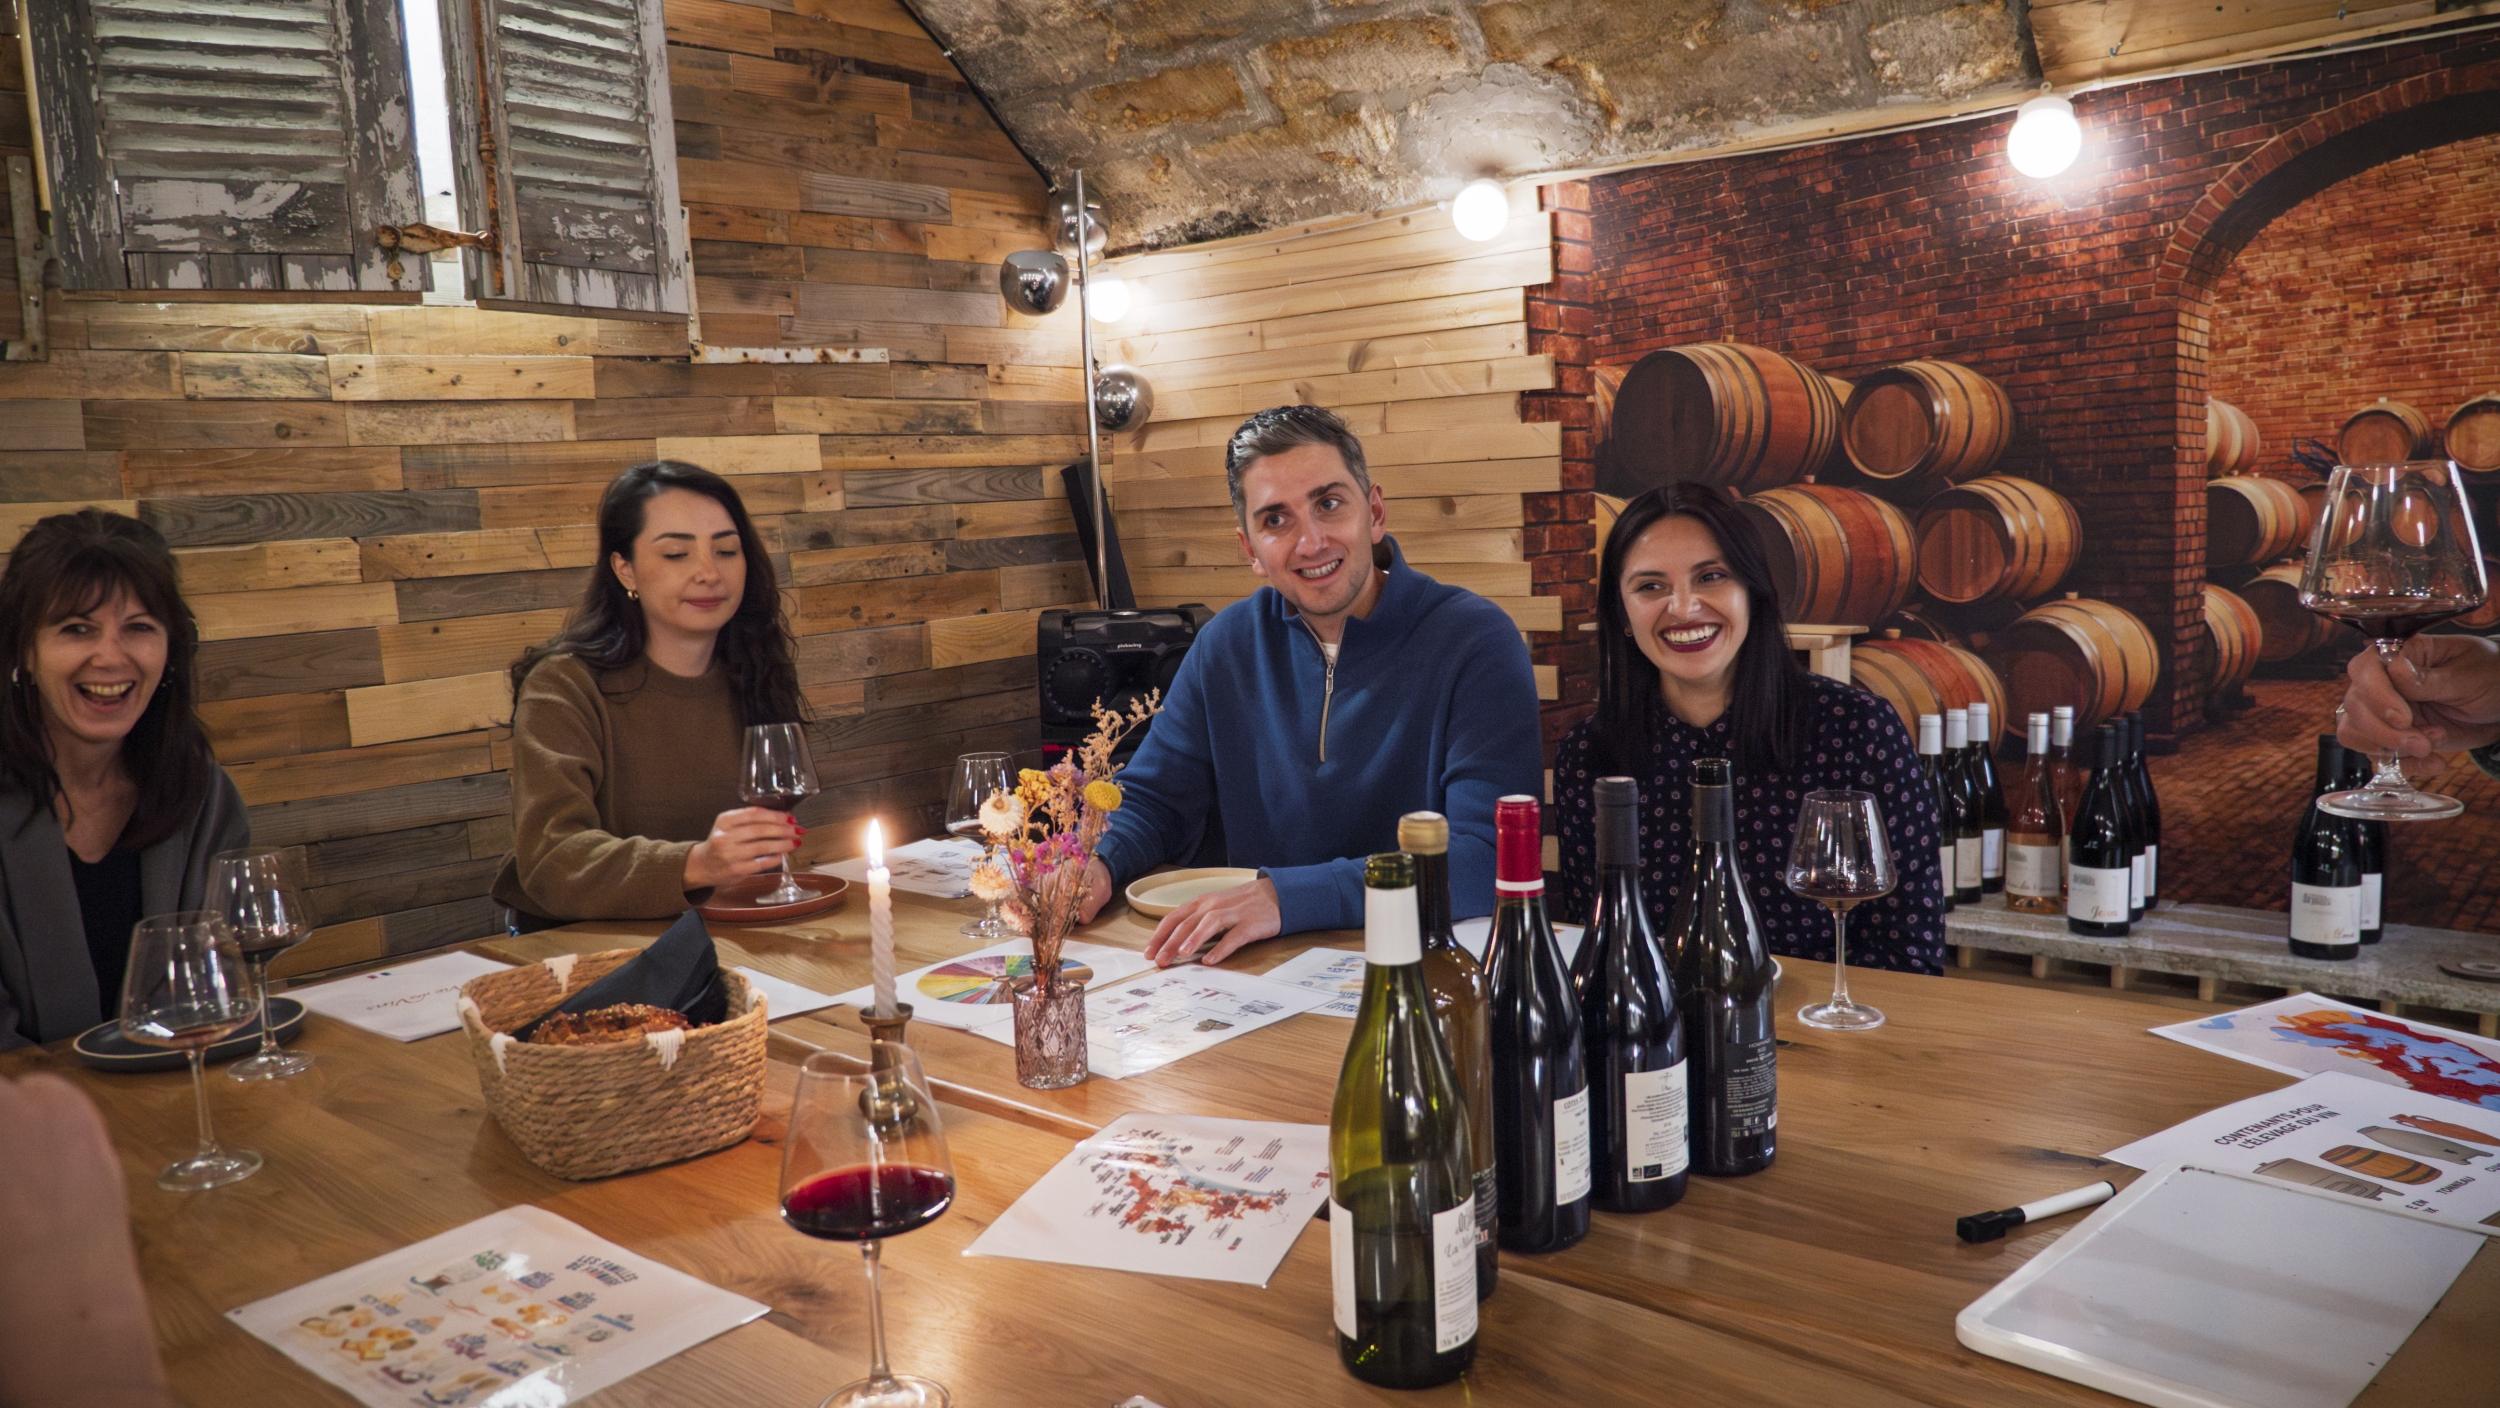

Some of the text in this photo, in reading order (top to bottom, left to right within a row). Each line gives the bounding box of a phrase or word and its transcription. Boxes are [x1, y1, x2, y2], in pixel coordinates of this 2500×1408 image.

[2214, 1103, 2328, 1145] CONTENANTS POUR
[2238, 1110, 2341, 1149] L'ÉLEVAGE DU VIN
